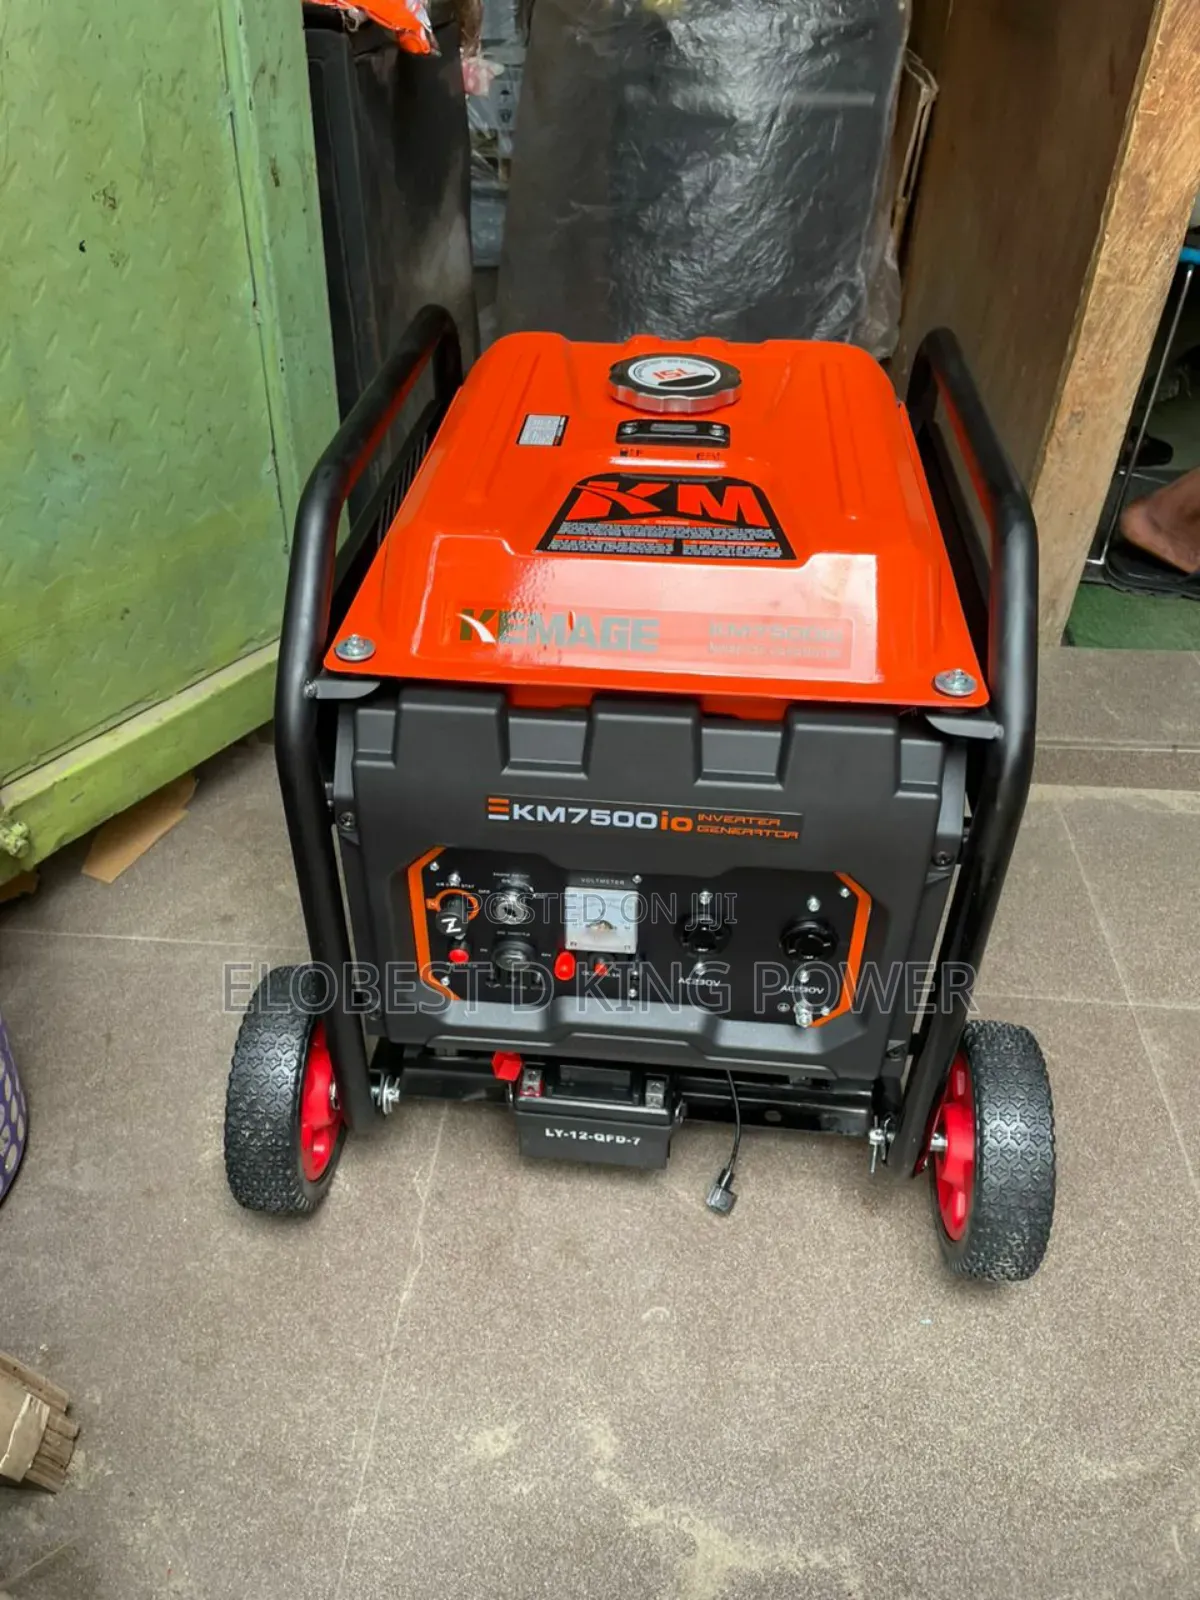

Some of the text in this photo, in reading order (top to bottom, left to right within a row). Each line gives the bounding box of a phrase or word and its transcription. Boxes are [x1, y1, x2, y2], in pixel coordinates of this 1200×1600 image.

[567, 481, 771, 527] KM
[456, 609, 660, 653] KEMAGE
[697, 813, 781, 827] INVERTER
[696, 824, 800, 839] GENERATOR
[581, 877, 625, 886] VOLTMETER
